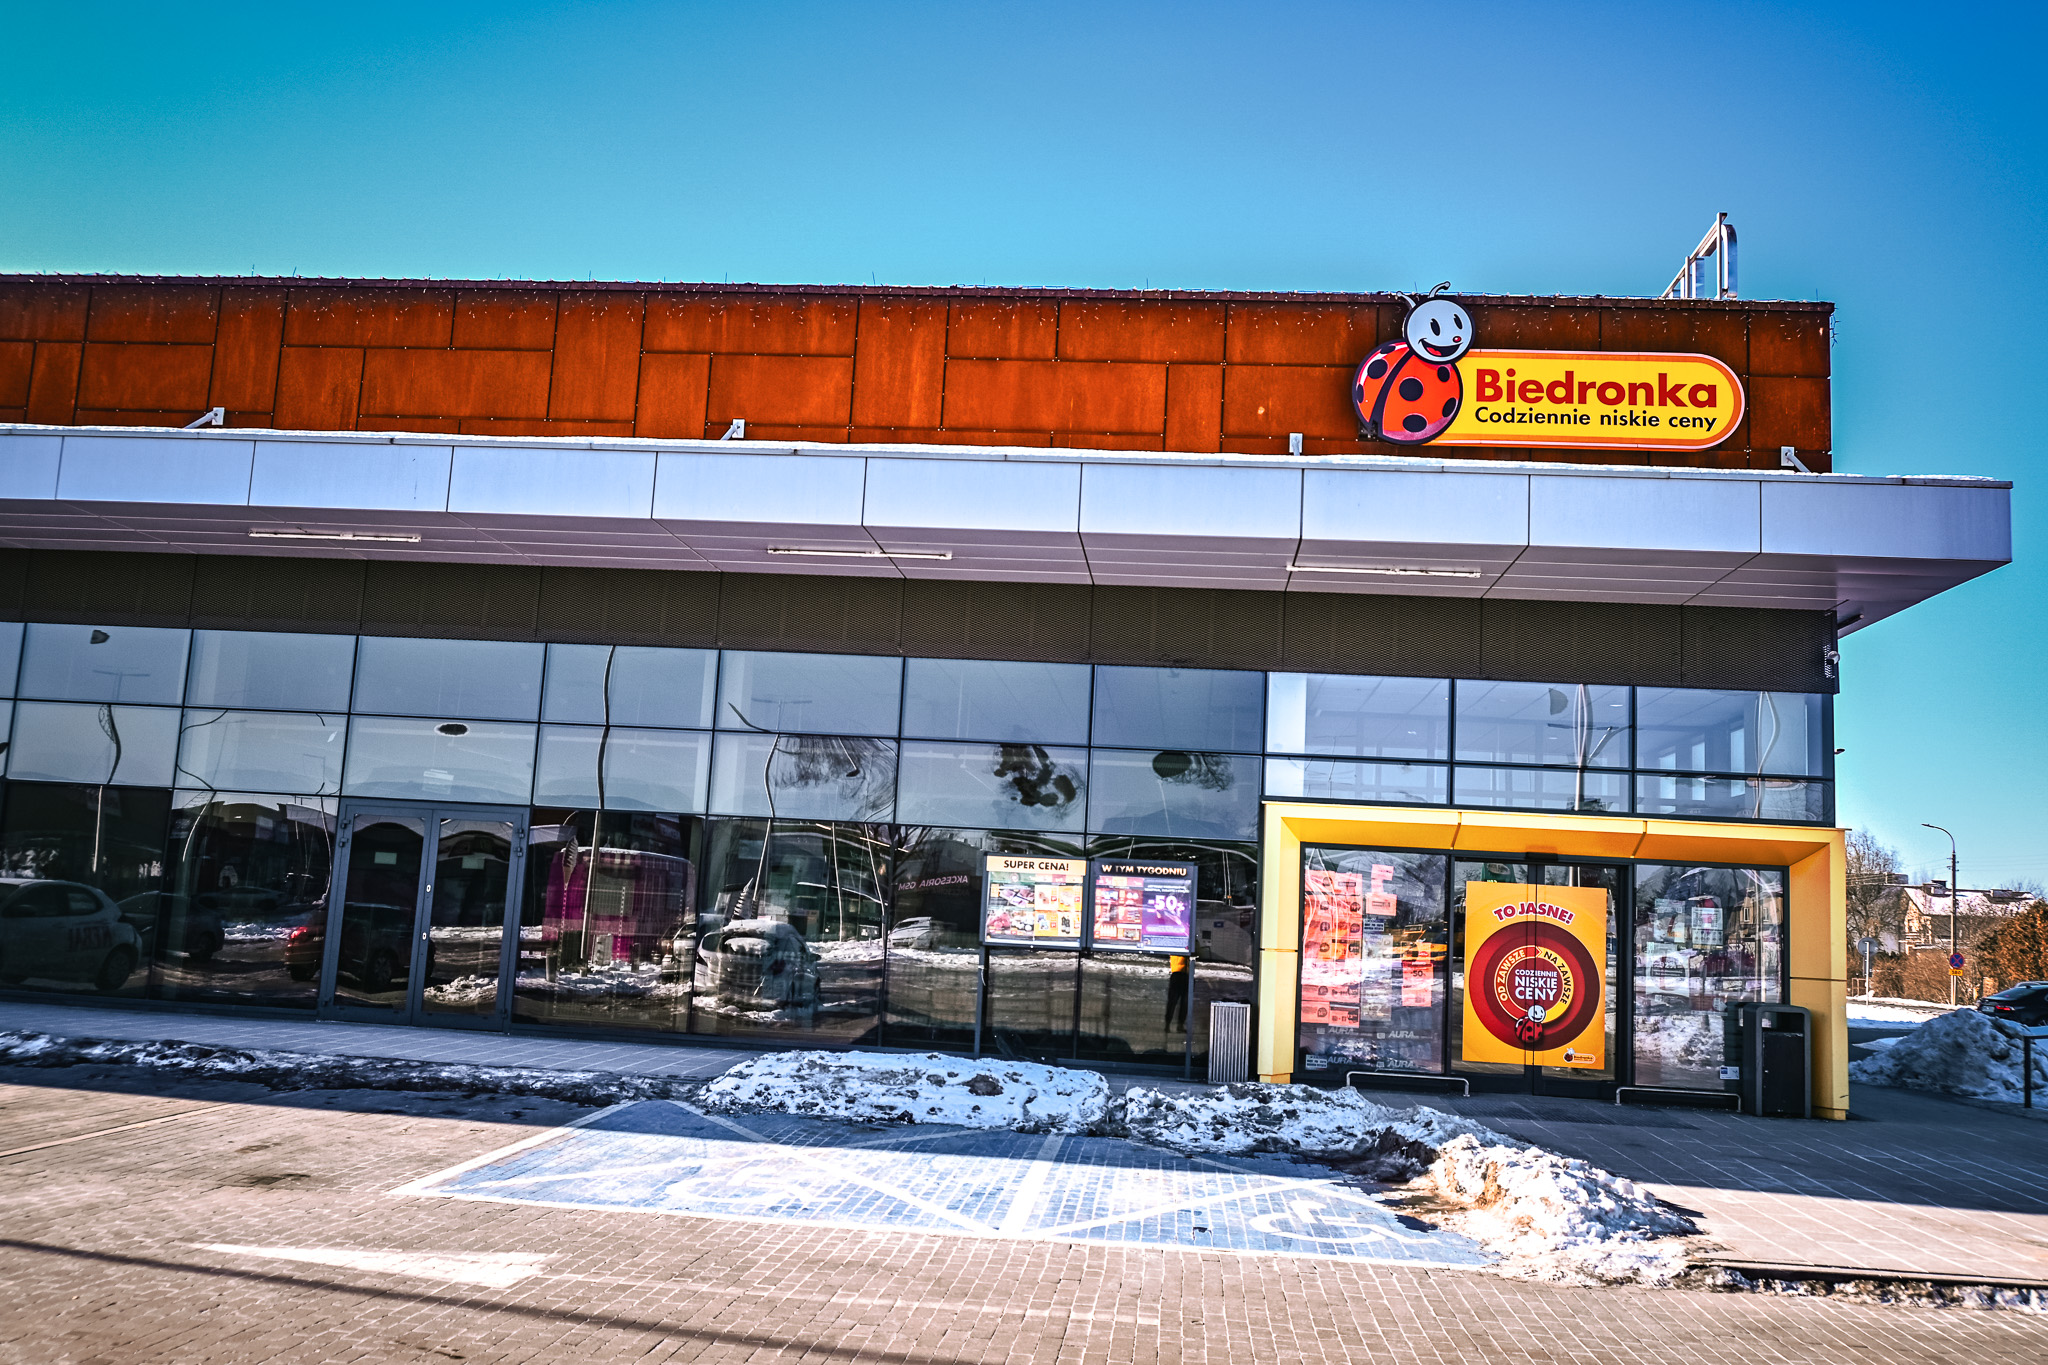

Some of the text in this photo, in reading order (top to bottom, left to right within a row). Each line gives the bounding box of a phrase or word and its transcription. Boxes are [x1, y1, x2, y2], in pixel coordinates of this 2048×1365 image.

[1475, 368, 1717, 408] Biedronka
[1475, 406, 1718, 432] Codziennie niskie ceny
[1003, 859, 1069, 872] SUPER CENA!
[1101, 864, 1187, 876] W TYM TYGODNIU
[1494, 902, 1575, 925] TO JASNE!
[1497, 949, 1525, 1002] OD ZAWSZE
[1515, 968, 1558, 978] CODZIENNIE
[1543, 950, 1572, 1005] NA ZAWSZE
[1514, 976, 1558, 989] NISKIE
[1515, 987, 1557, 1001] CENY
